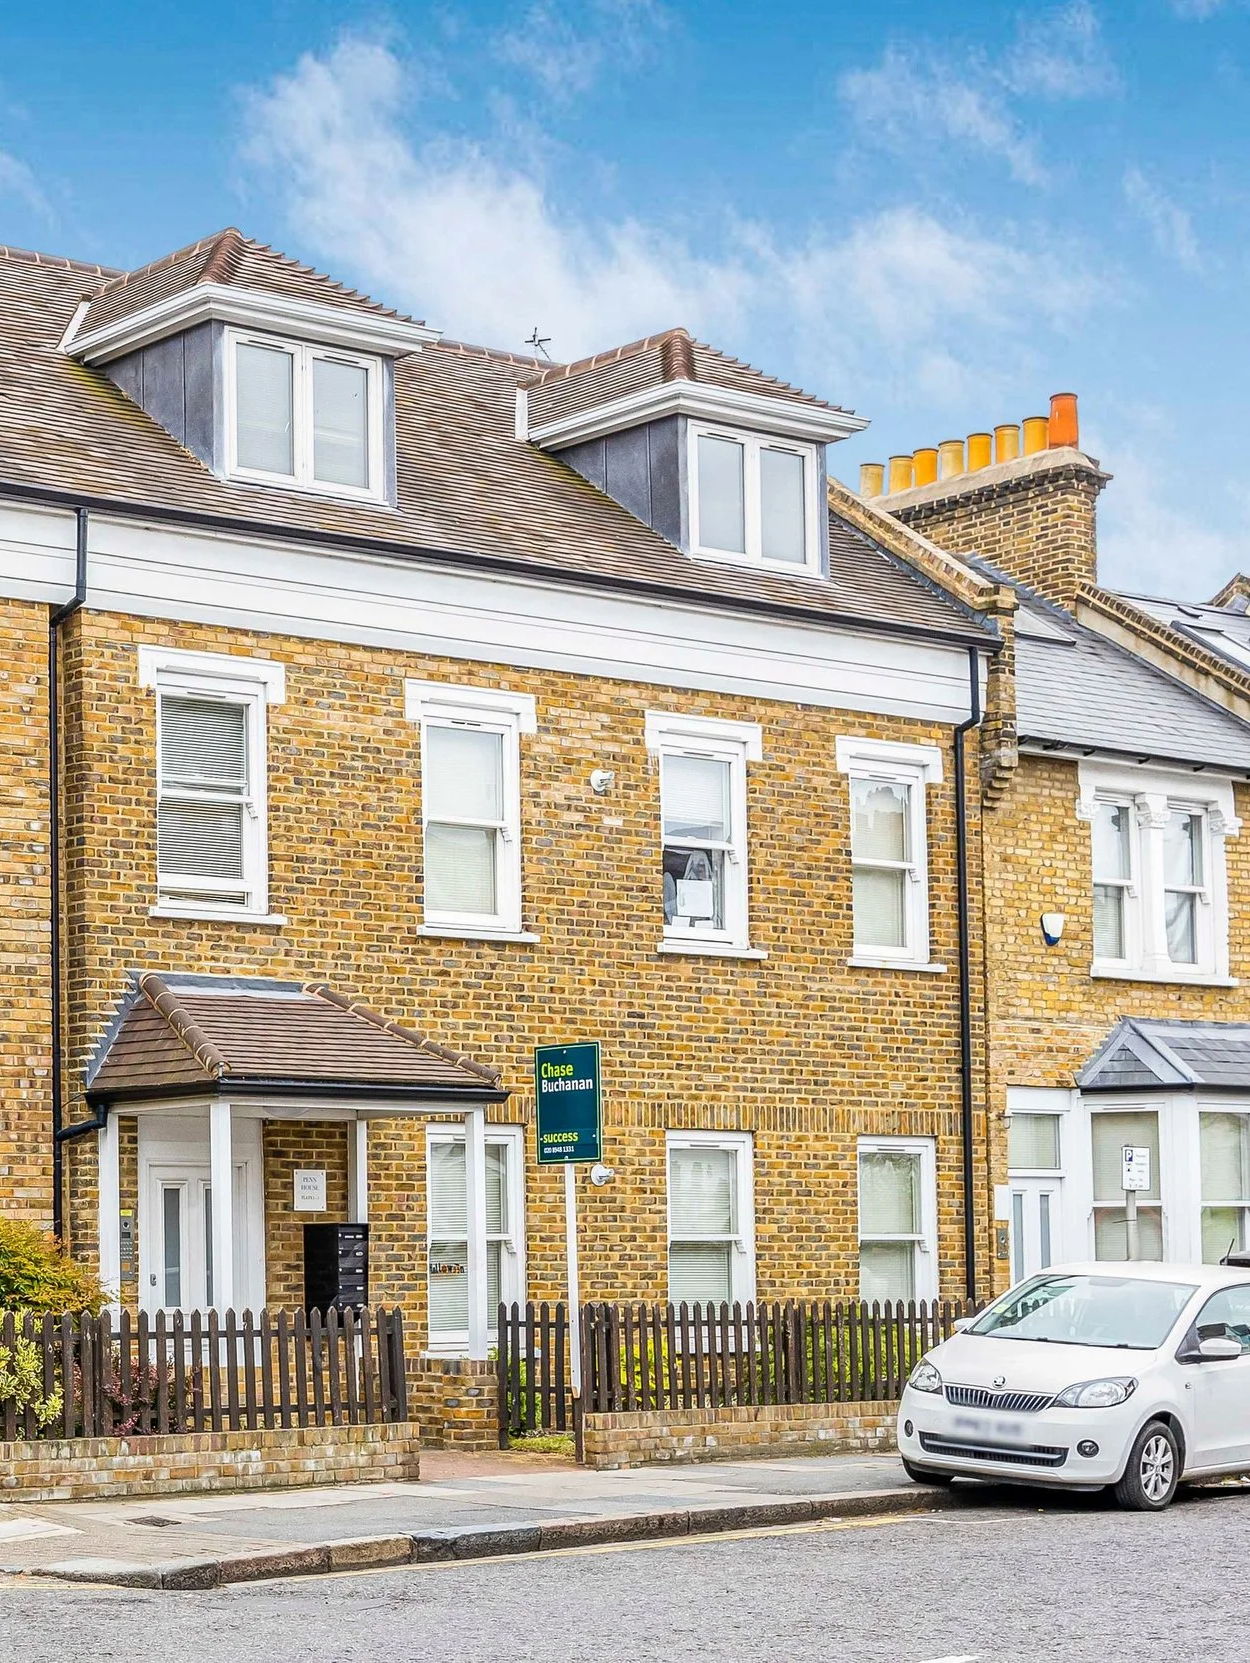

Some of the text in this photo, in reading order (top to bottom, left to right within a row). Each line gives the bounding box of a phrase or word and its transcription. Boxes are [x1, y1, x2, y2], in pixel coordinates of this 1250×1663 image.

[541, 1062, 574, 1079] Chase
[541, 1077, 594, 1093] Buchanan
[543, 1132, 579, 1144] success
